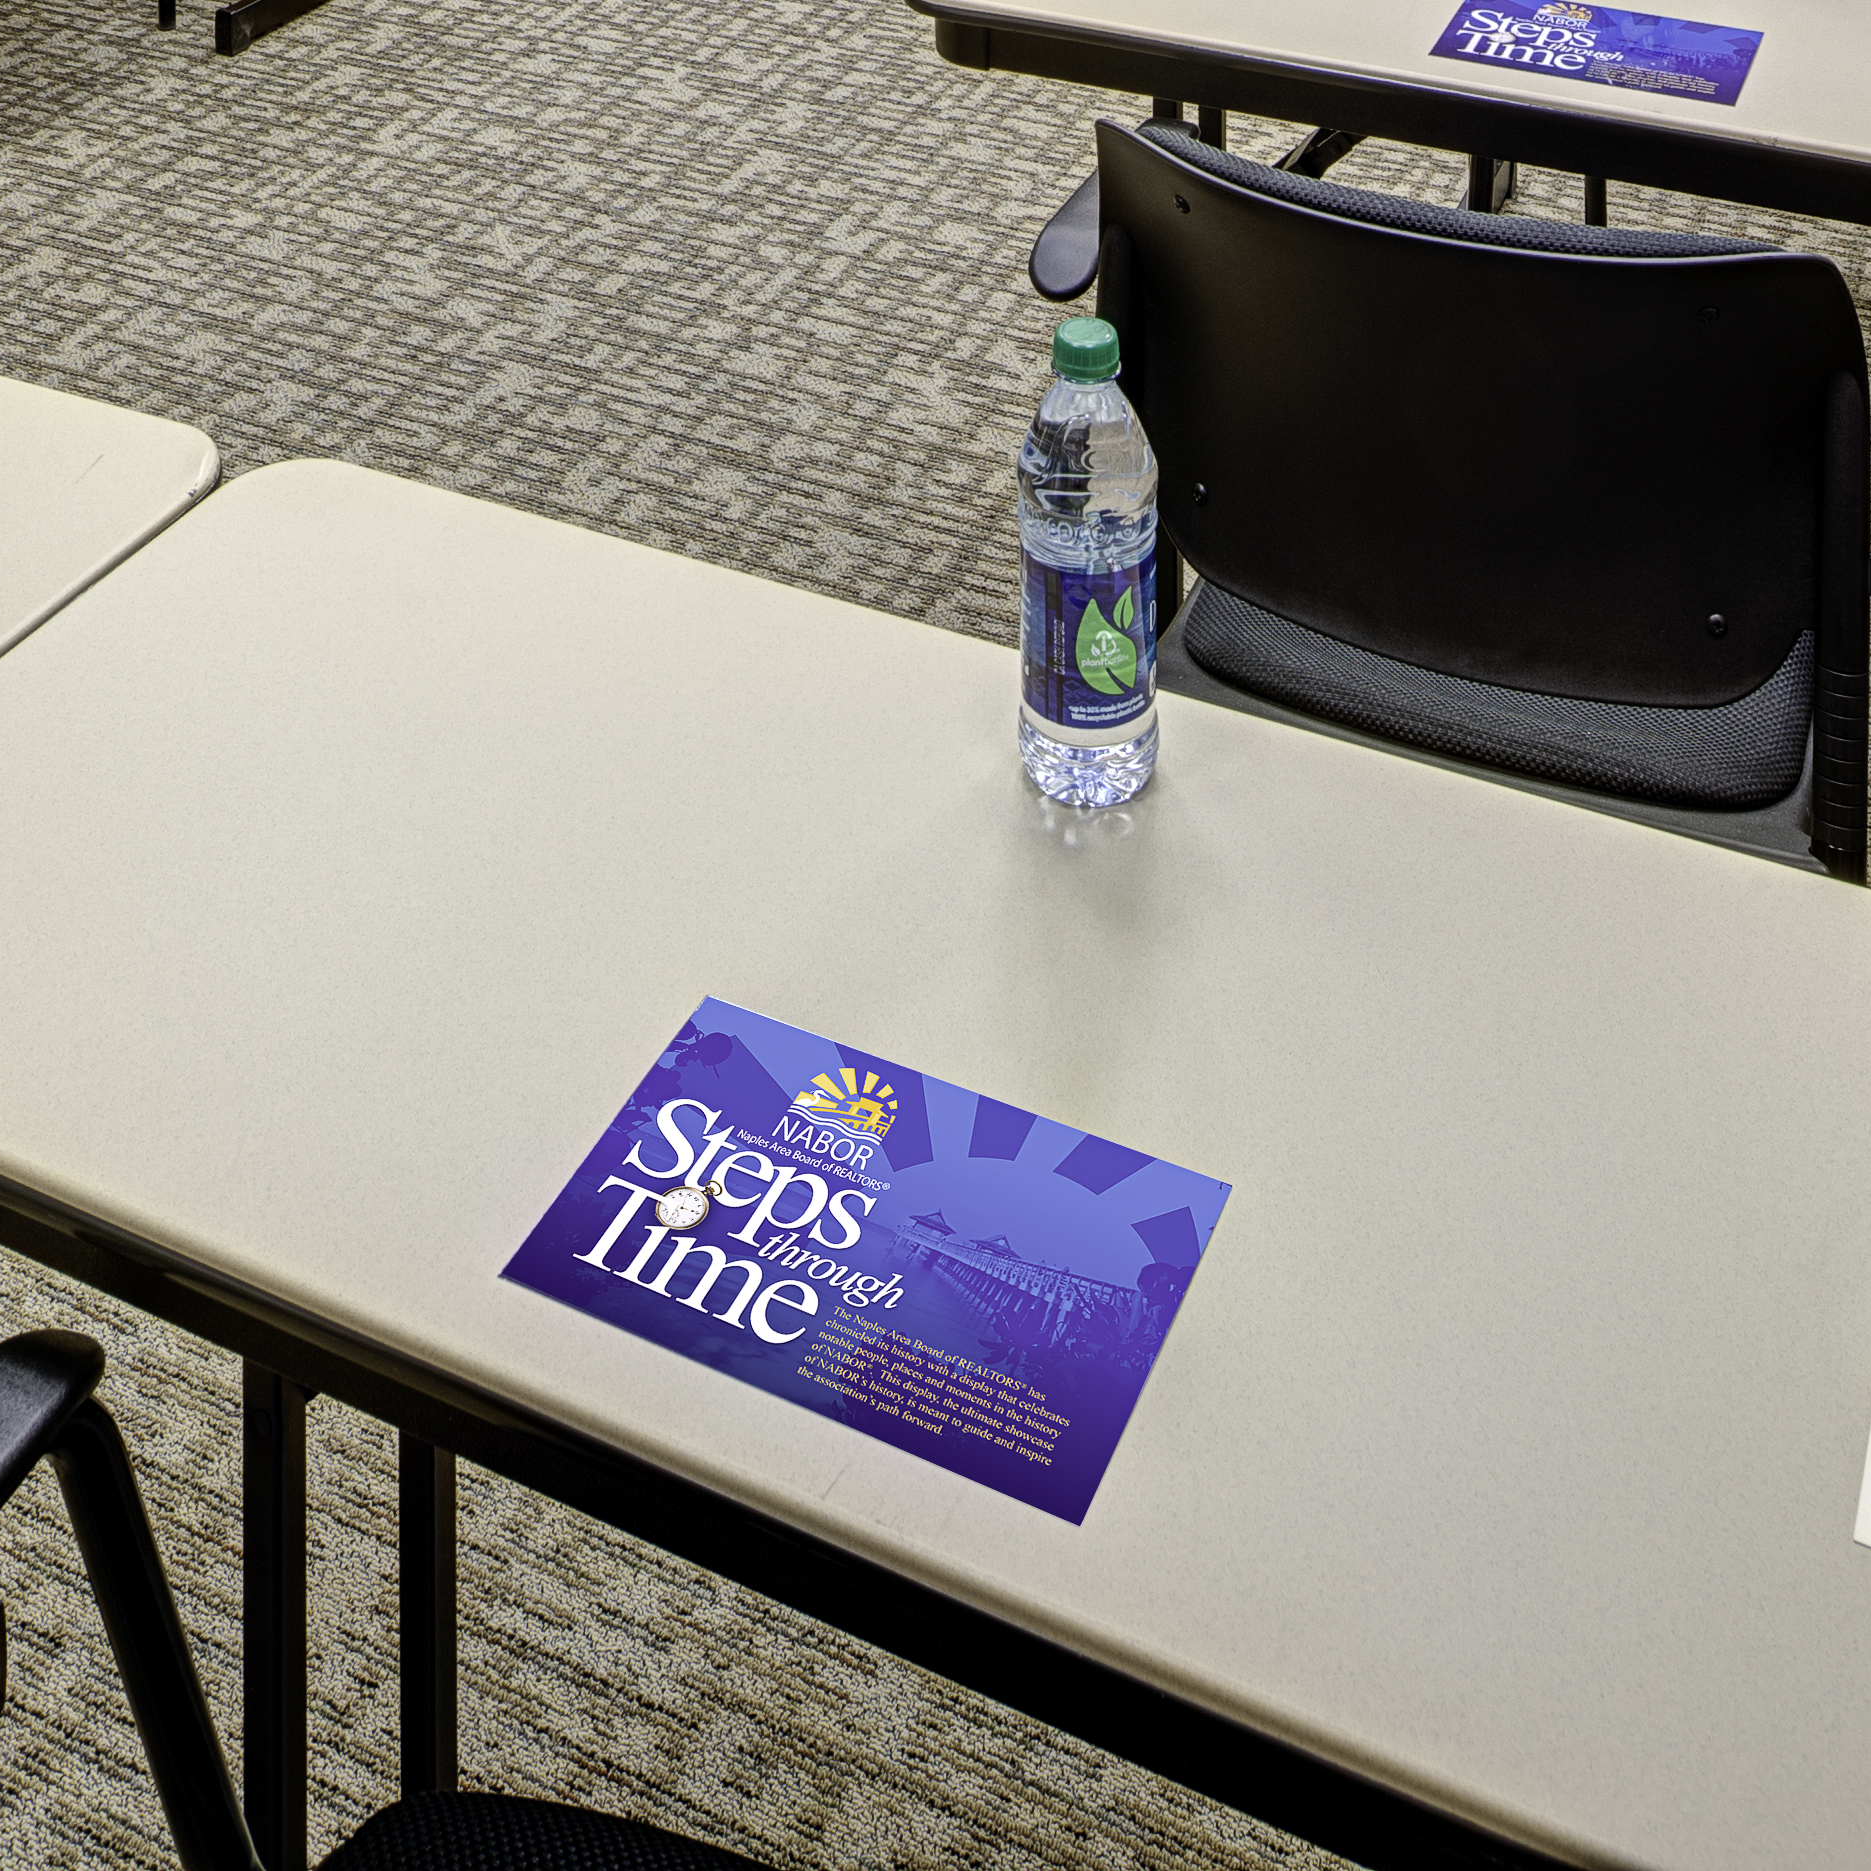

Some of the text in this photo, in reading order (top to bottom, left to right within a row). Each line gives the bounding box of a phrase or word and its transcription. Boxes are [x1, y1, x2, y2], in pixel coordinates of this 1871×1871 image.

[1456, 28, 1587, 71] Time
[1462, 9, 1597, 48] Steps
[1533, 14, 1588, 29] NABOR
[1547, 42, 1625, 62] through
[621, 1098, 878, 1249] Steps
[736, 1128, 770, 1148] Naples
[768, 1141, 793, 1157] Area
[791, 1149, 824, 1168] Board
[821, 1163, 836, 1173] of
[771, 1115, 874, 1171] NABOR
[573, 1174, 819, 1344] Time
[757, 1232, 905, 1310] through
[818, 1331, 1062, 1439] notable people, places and moments in the history
[825, 1319, 1071, 1427] chronicled its history with a display that celebrates
[833, 1305, 852, 1321] The
[852, 1314, 887, 1335] Naples
[886, 1329, 912, 1346] Area
[912, 1339, 945, 1359] Board
[944, 1354, 960, 1364] of
[1027, 1386, 1047, 1402] has
[797, 1366, 814, 1379] the
[875, 1401, 900, 1417] path
[901, 1410, 944, 1436] forward.
[804, 1355, 820, 1365] of
[868, 1379, 905, 1405] history,
[906, 1396, 917, 1408] is
[917, 1403, 950, 1423] meant
[950, 1417, 963, 1427] to
[961, 1423, 994, 1441] guide
[993, 1436, 1016, 1450] and
[1015, 1442, 1053, 1466] inspire
[811, 1343, 827, 1353] of
[880, 1369, 902, 1386] This
[902, 1380, 940, 1404] display,
[942, 1397, 960, 1411] the
[960, 1406, 1003, 1430] ultimate
[1003, 1424, 1055, 1452] showcase
